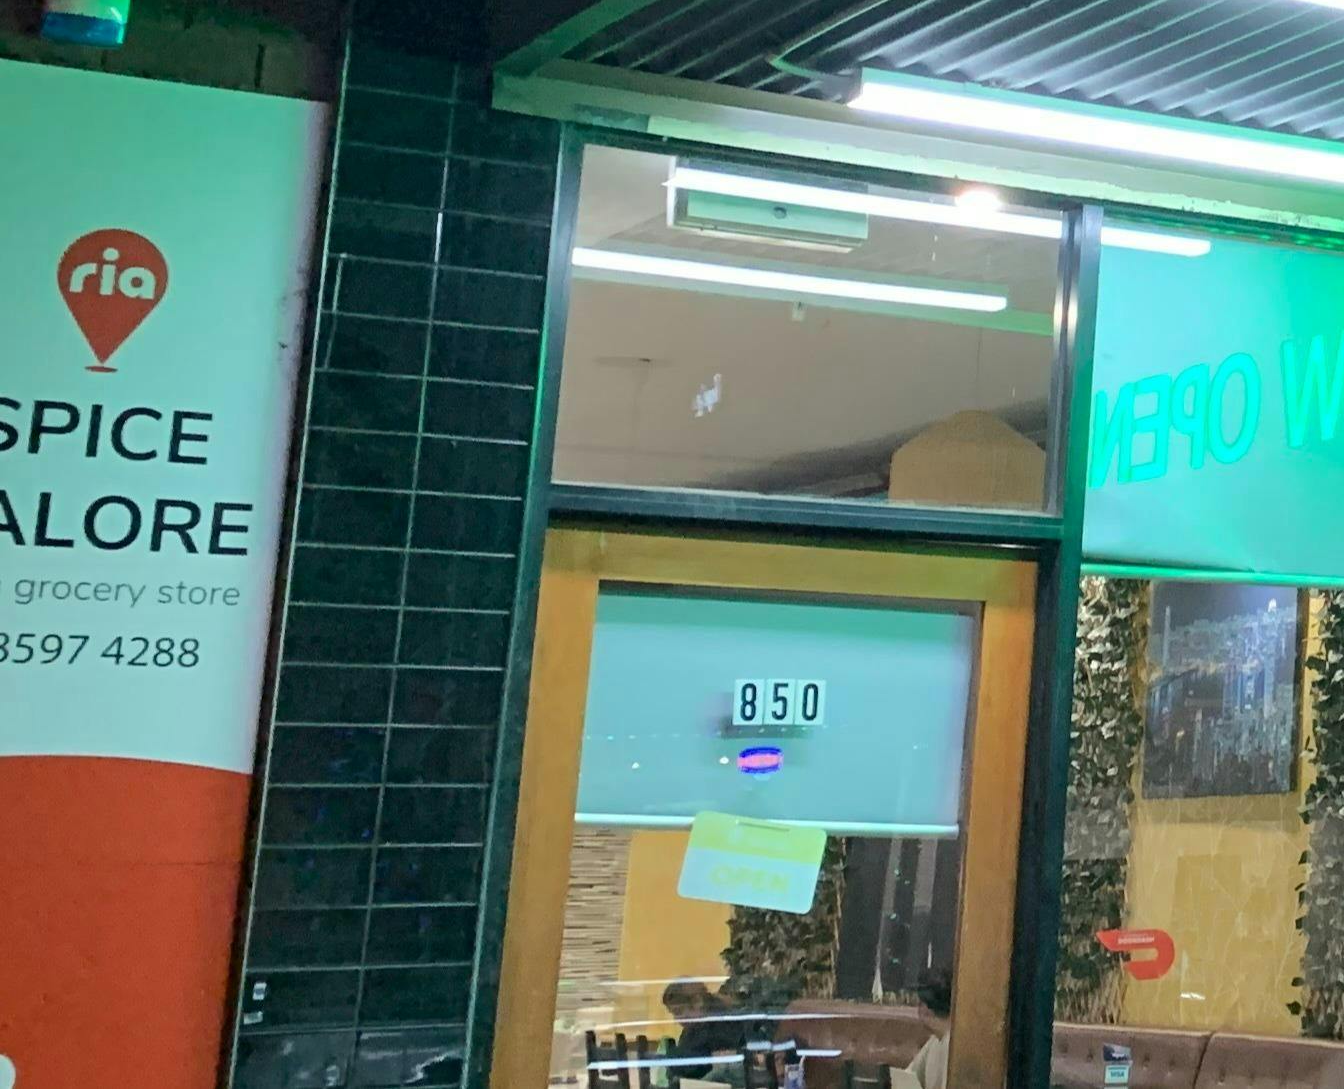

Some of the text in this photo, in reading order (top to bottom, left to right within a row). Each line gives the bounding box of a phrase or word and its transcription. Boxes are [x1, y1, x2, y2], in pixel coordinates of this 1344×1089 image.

[68, 246, 156, 300] ria
[14, 578, 241, 609] grocery store
[99, 635, 201, 669] 4288
[738, 682, 820, 723] 850
